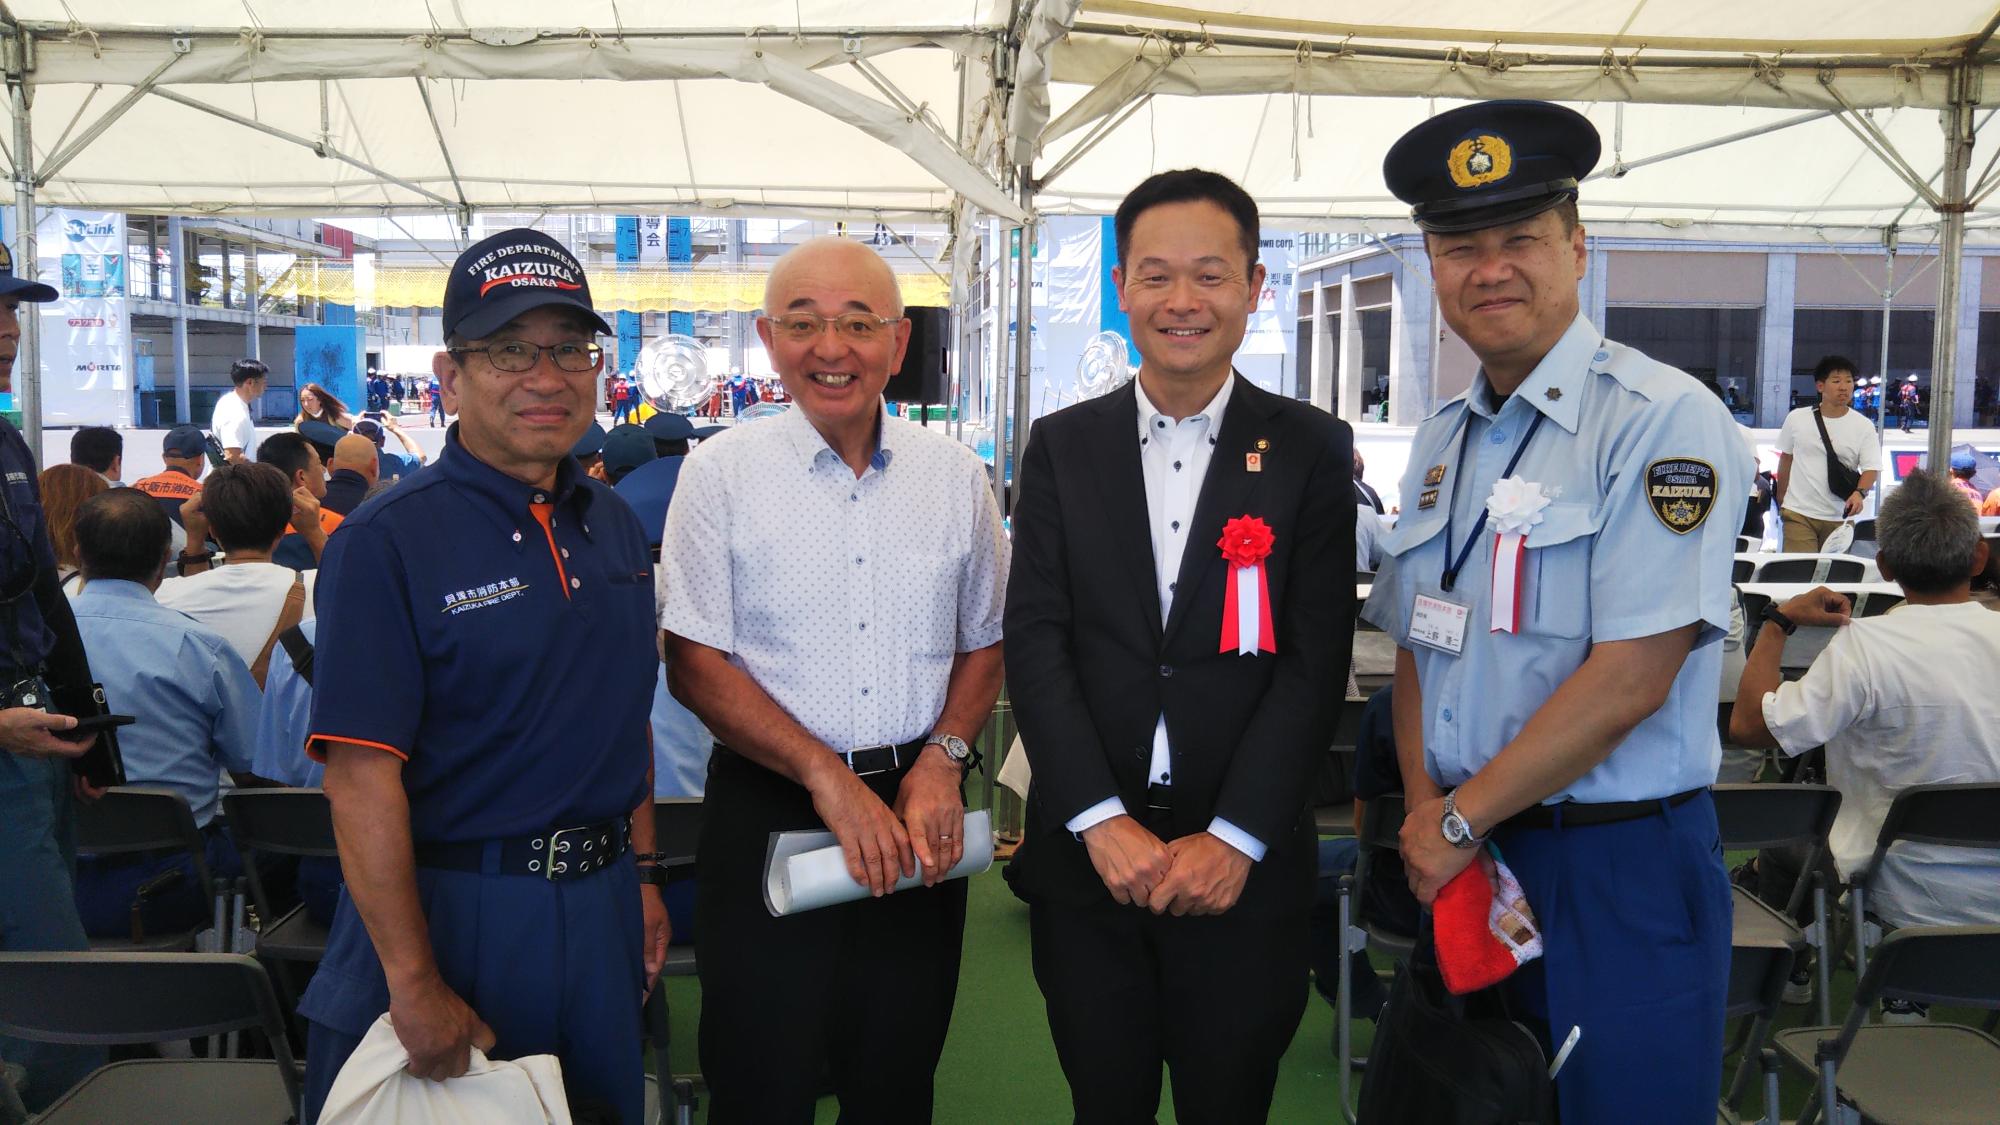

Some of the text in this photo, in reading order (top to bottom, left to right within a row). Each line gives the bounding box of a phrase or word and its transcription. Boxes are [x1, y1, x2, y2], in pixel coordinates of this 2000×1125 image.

[617, 226, 624, 236] 7
[1275, 239, 1295, 251] corp.
[467, 243, 582, 277] FIRE DEPARTMENT
[483, 262, 575, 283] KAIZUKA
[511, 277, 559, 288] OSAKA
[76, 362, 121, 372] MORITA
[1652, 463, 1679, 477] FIRE
[1665, 474, 1697, 484] OSAKA
[1651, 485, 1711, 498] KAIZUKA
[444, 576, 520, 606] 貝塚市消防本部
[451, 601, 484, 615] KAIZUKA
[483, 597, 501, 607] FIRE
